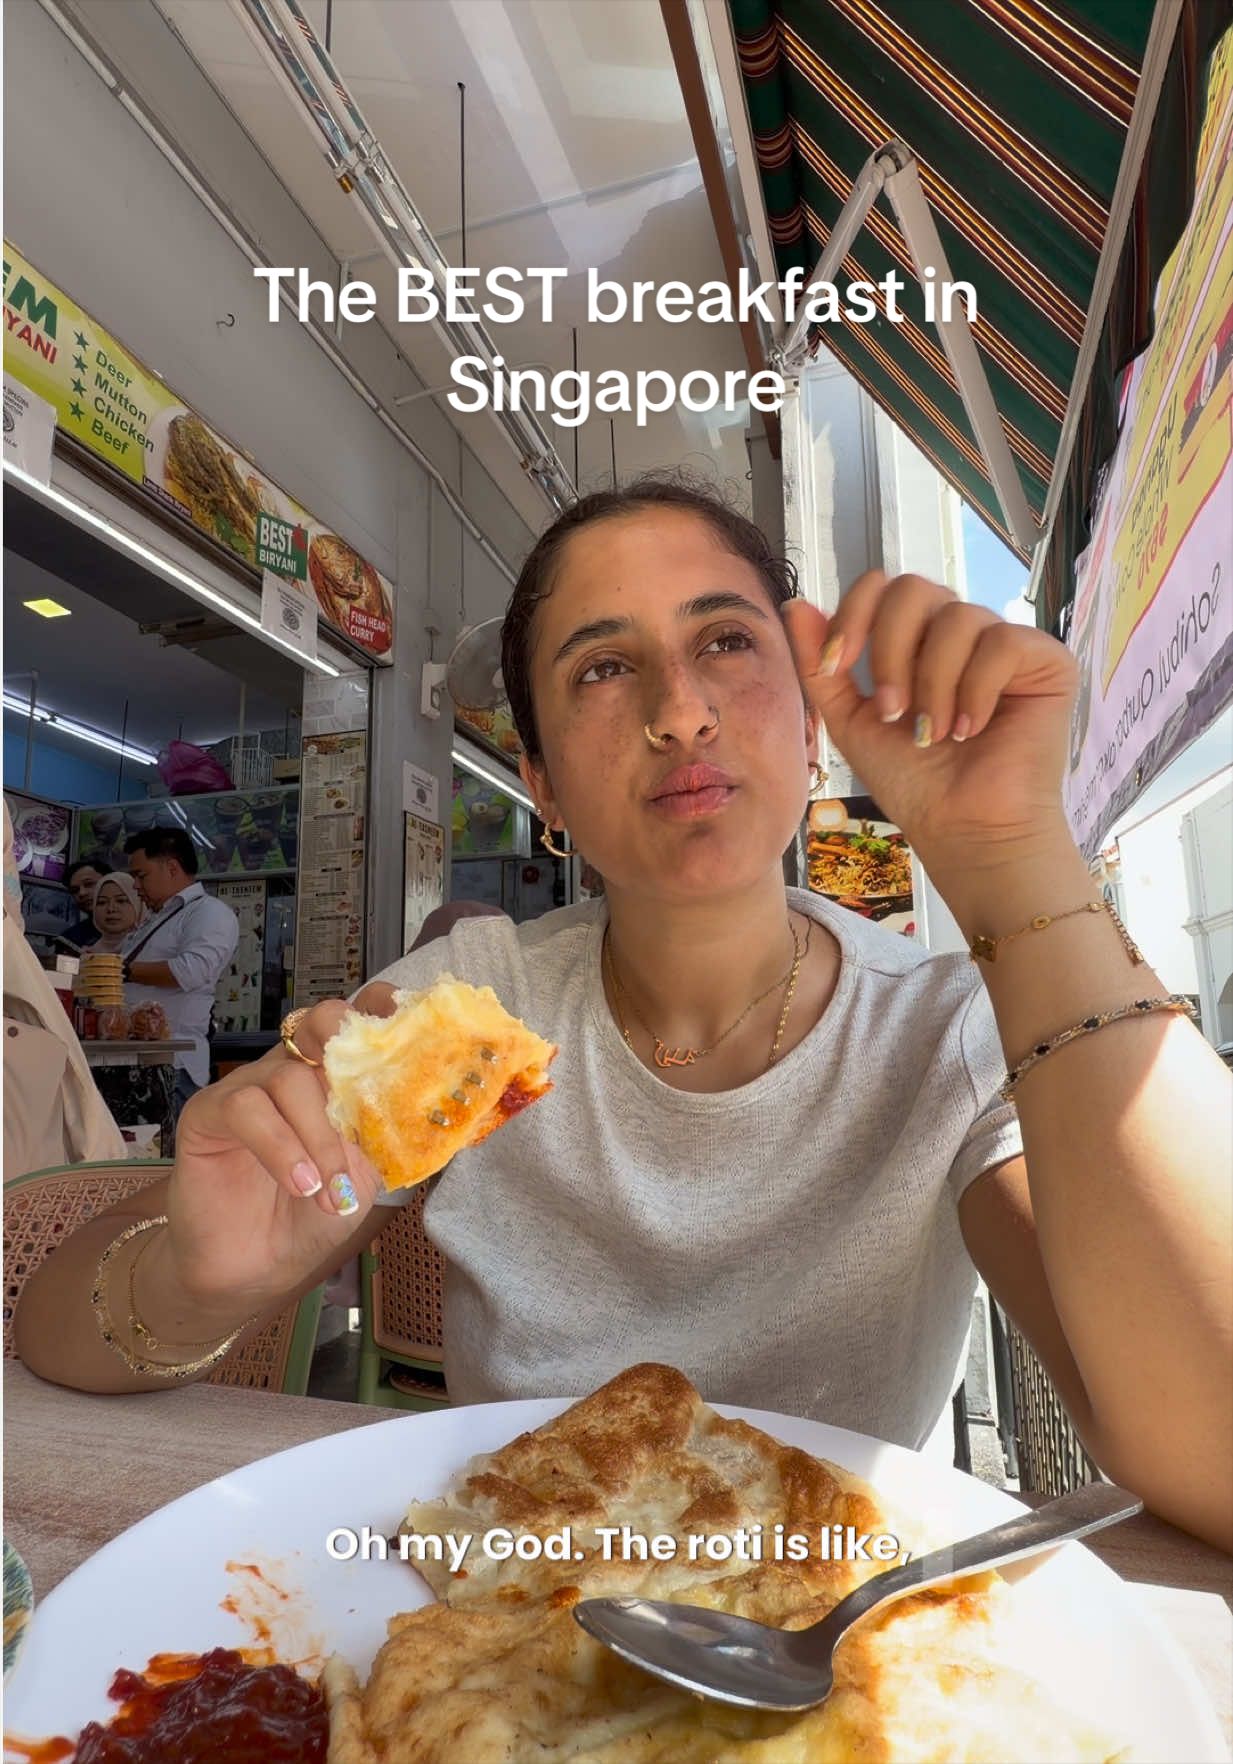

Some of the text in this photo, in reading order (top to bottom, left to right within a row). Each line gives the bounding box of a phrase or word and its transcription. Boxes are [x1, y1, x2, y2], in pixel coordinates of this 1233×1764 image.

[3, 304, 58, 365] YANI
[96, 350, 133, 388] Deer
[94, 372, 148, 424] Mutton
[91, 418, 129, 455] Beef
[94, 397, 154, 453] Chicken
[260, 517, 293, 554] BEST
[259, 551, 297, 573] BIRYANI
[350, 625, 375, 642] CURRY
[351, 611, 387, 633] FISH HEAD
